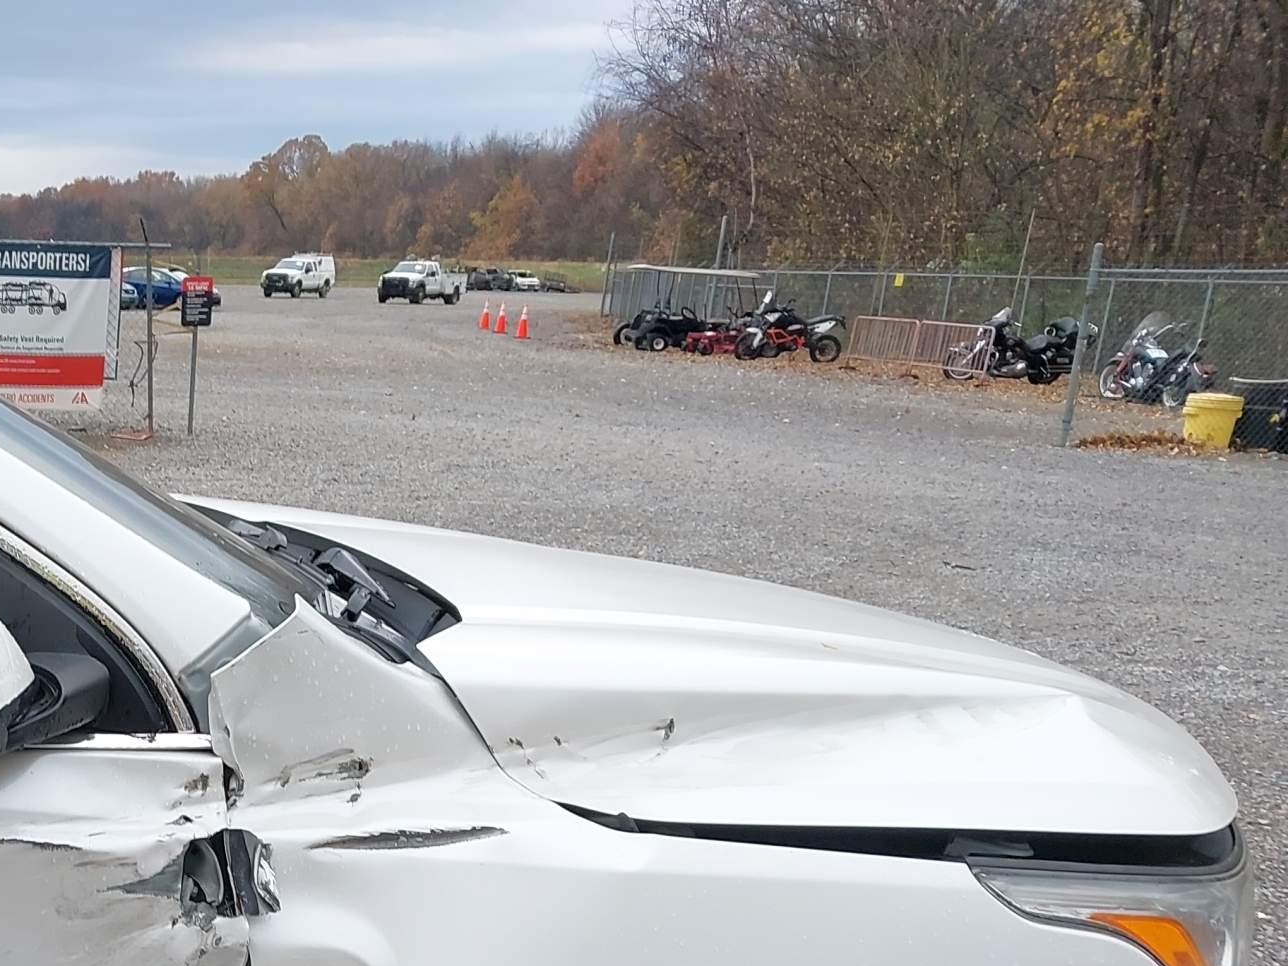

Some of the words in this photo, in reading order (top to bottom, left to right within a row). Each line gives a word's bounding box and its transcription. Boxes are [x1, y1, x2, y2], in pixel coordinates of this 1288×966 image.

[20, 335, 34, 343] Vest
[35, 335, 64, 345] Required
[18, 393, 55, 403] ACCIDENTS
